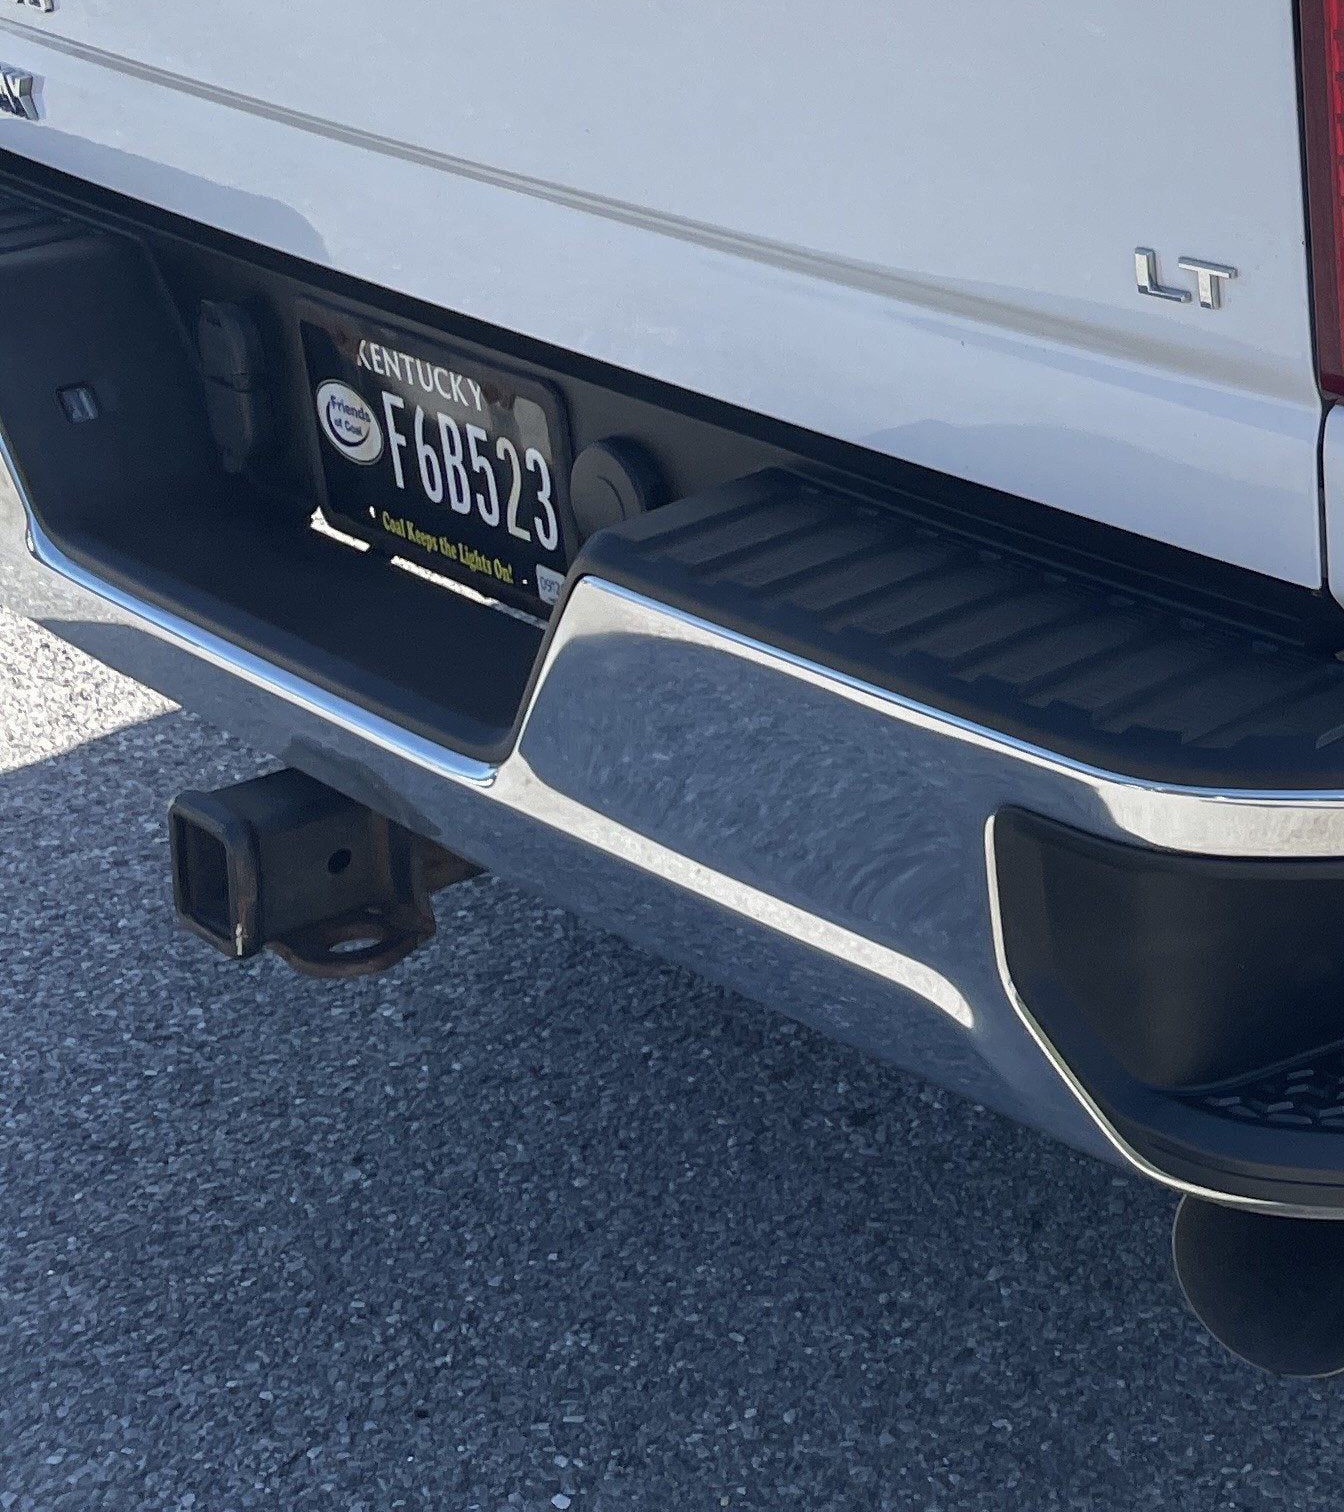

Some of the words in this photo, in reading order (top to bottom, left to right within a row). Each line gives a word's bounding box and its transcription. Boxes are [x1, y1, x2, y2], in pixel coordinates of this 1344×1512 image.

[1134, 246, 1238, 309] LT
[357, 339, 482, 411] KENTUCKY
[382, 390, 558, 551] F6B523
[406, 520, 438, 552] Keeps
[439, 536, 457, 560] the
[458, 542, 492, 575] Lights
